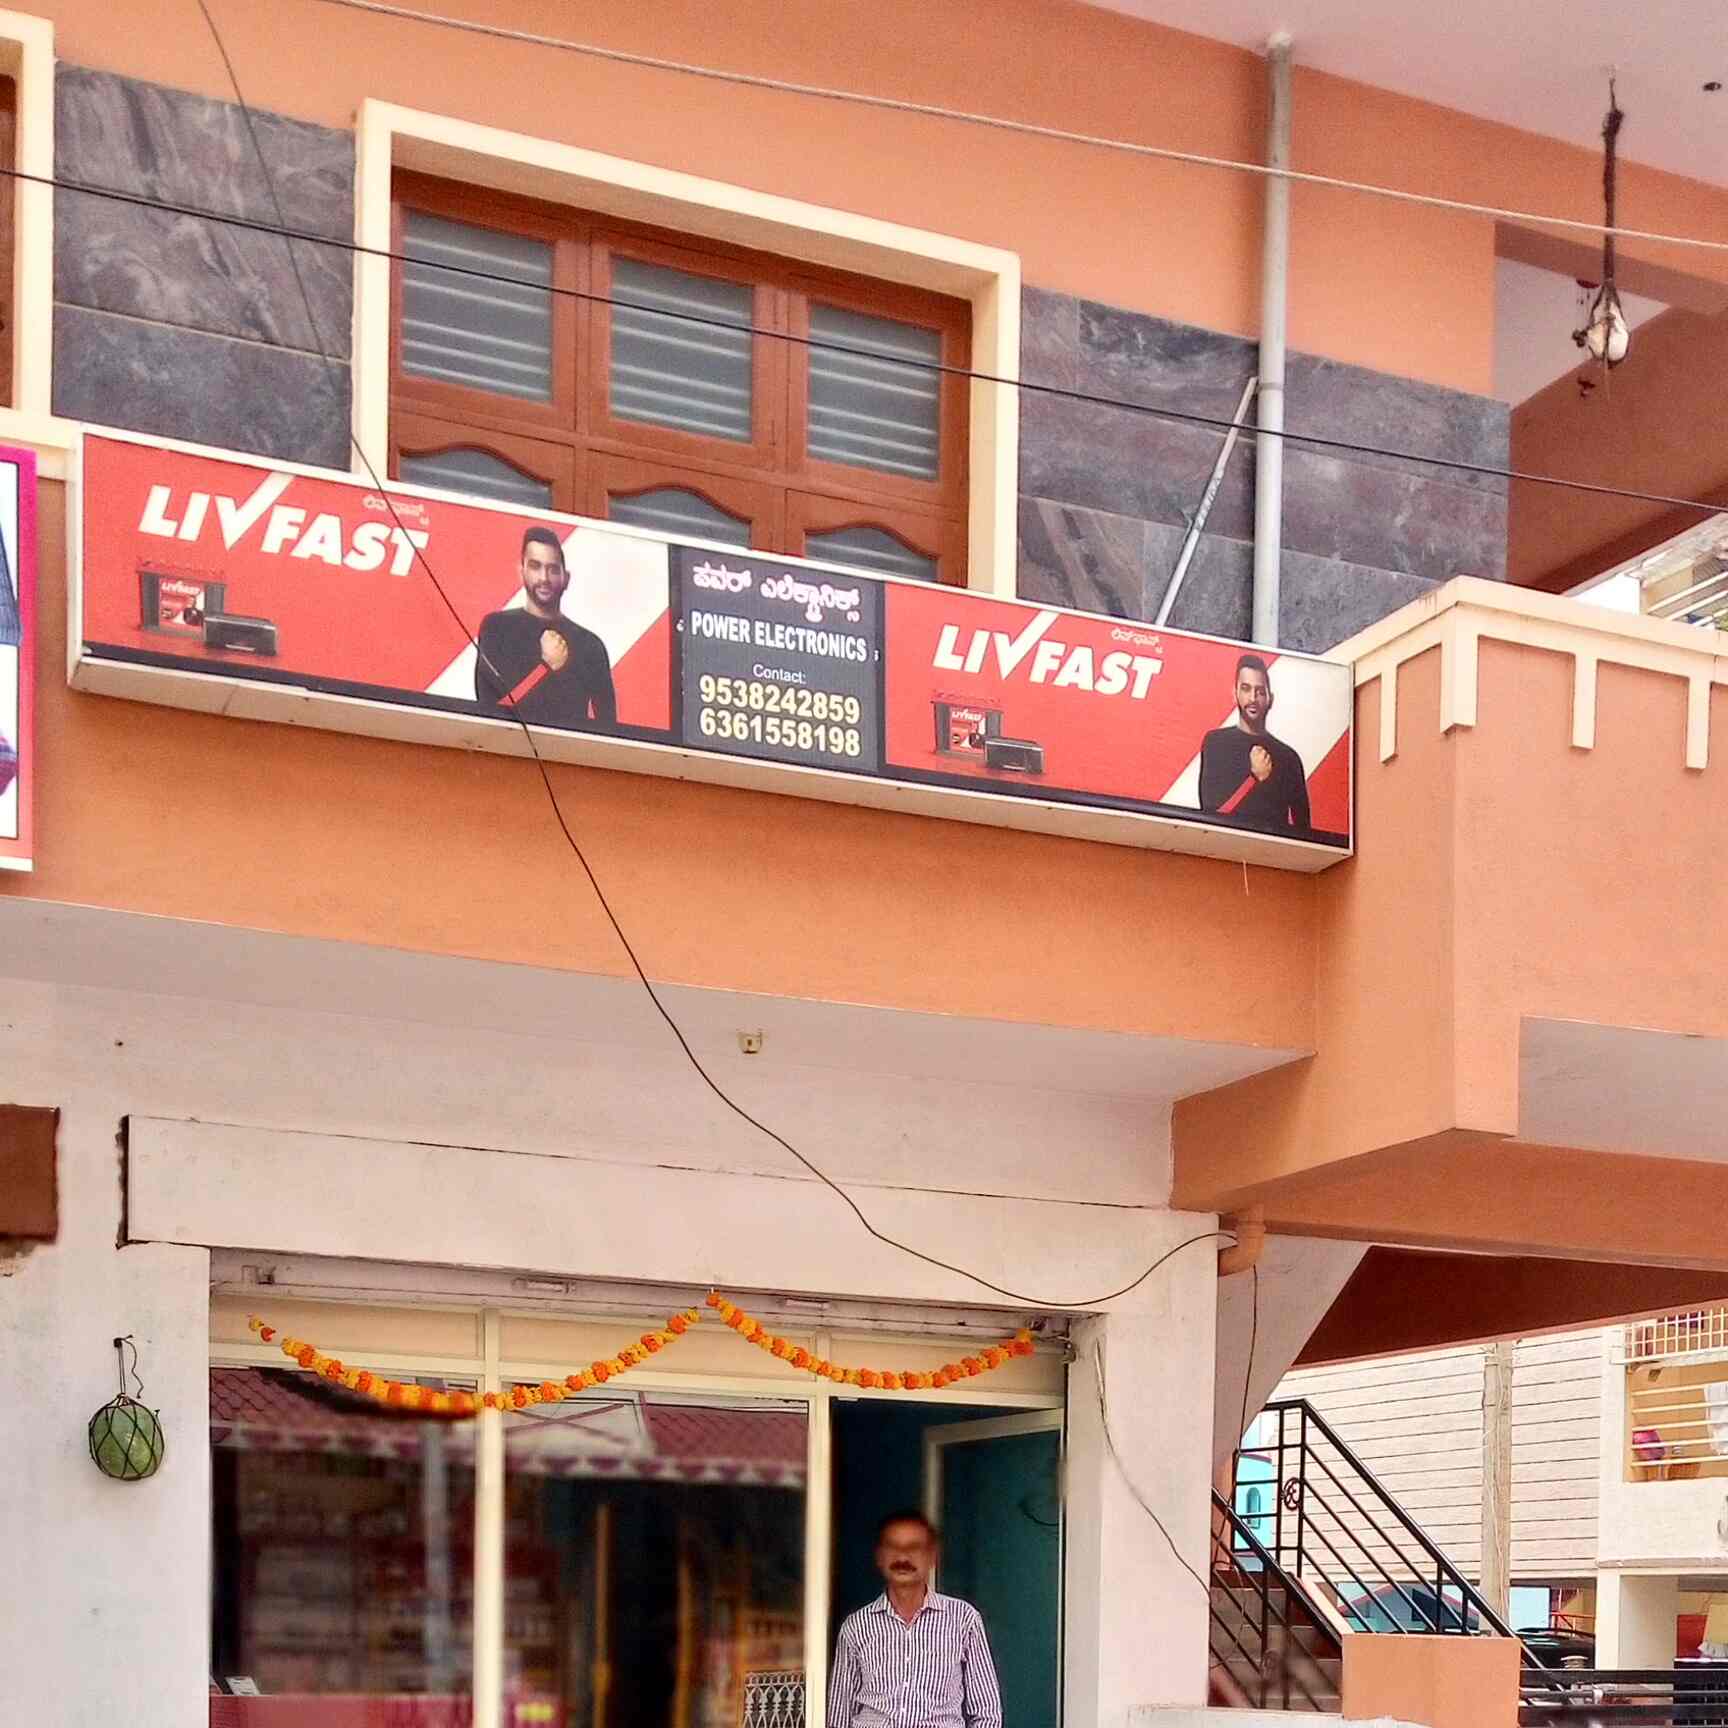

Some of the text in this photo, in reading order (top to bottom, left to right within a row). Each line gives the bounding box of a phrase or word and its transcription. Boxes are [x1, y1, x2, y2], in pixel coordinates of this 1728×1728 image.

[139, 471, 430, 577] LIVFAST
[692, 561, 752, 592] ಪವರ್
[691, 611, 867, 662] POWER ELECTRONICS
[932, 611, 1164, 700] LIVFAST
[699, 674, 860, 724] 9538242859
[753, 664, 807, 685] Contact:
[699, 707, 860, 756] 6361558198
